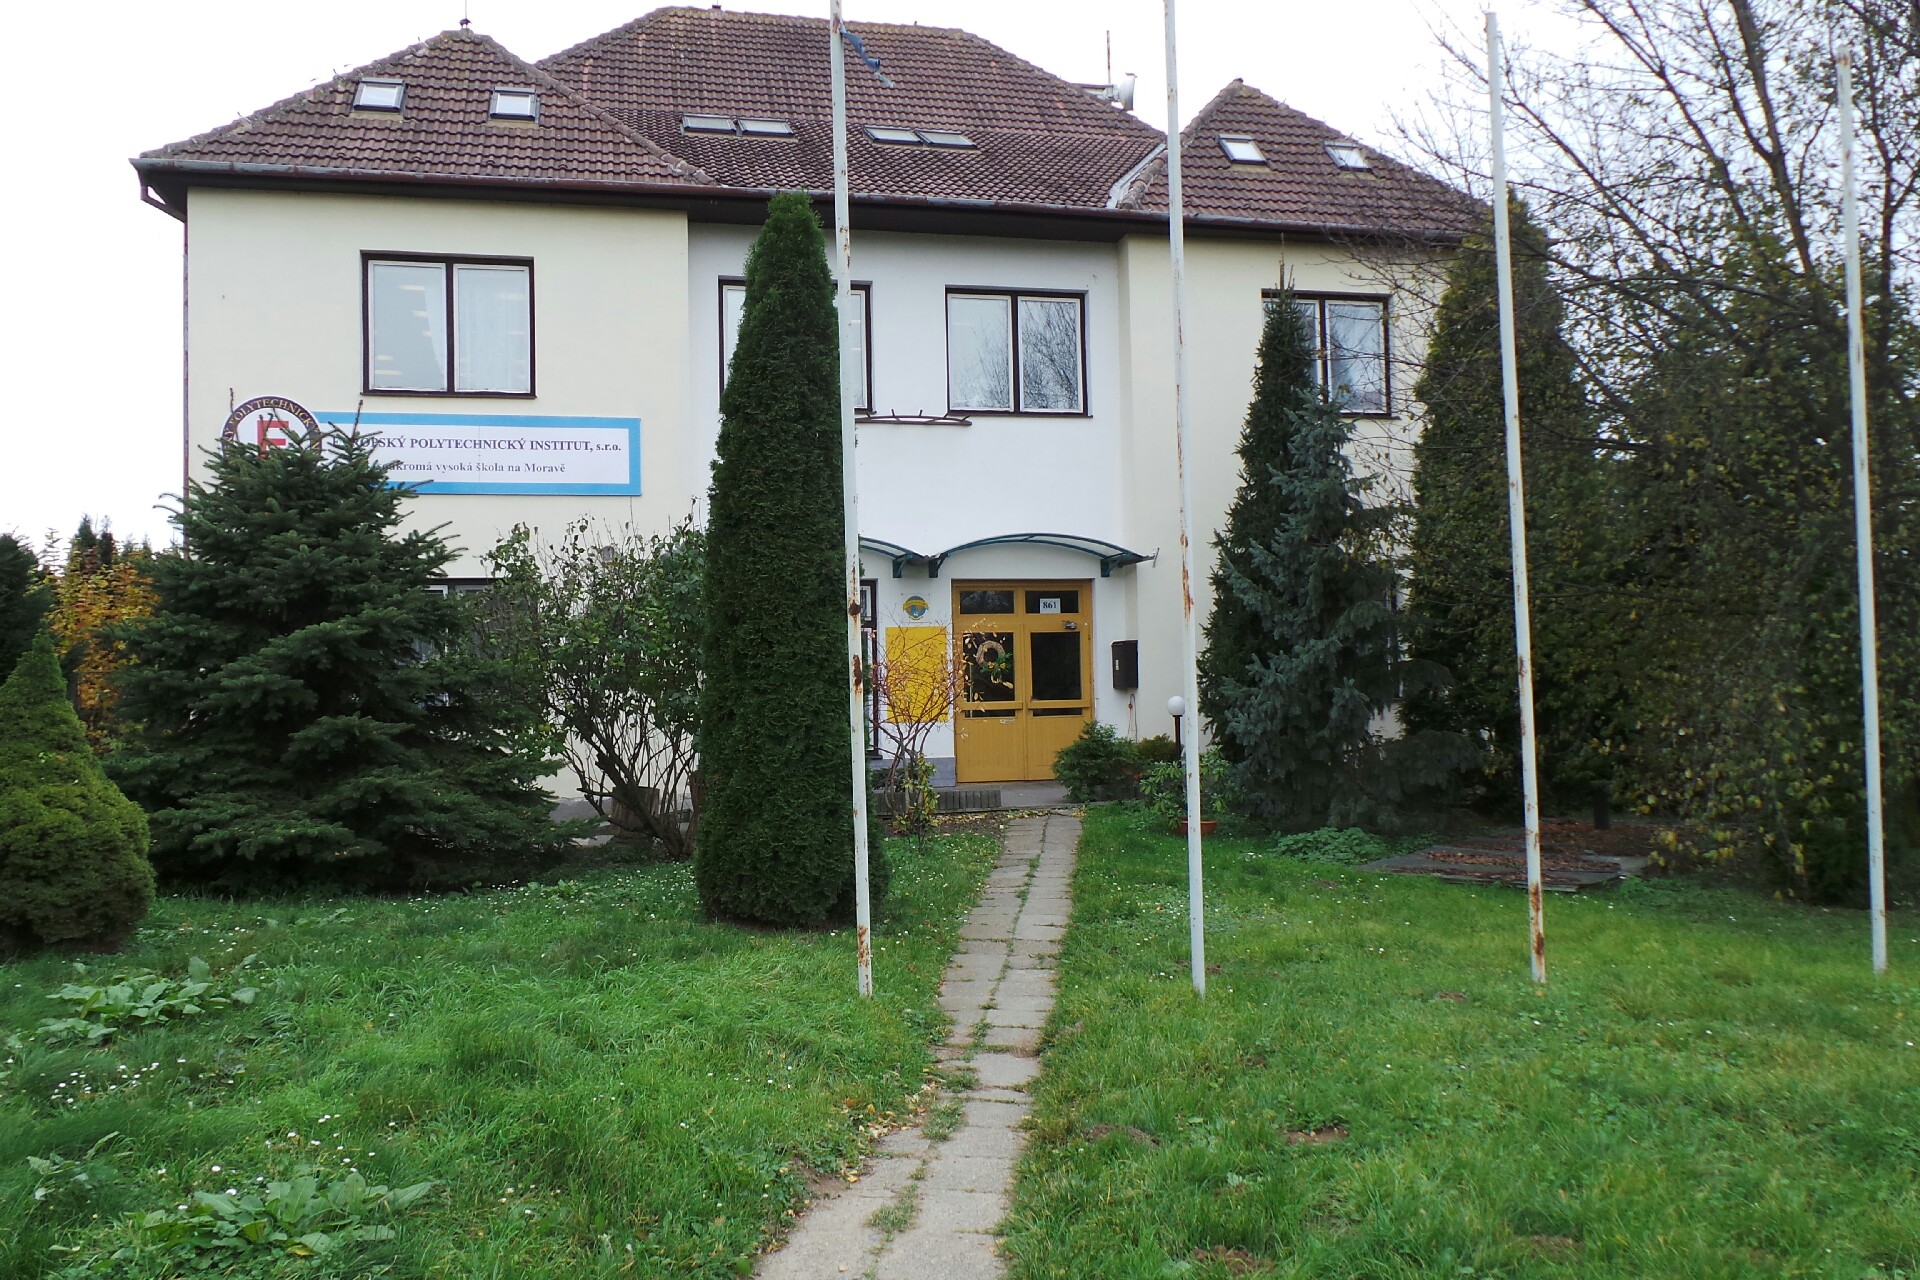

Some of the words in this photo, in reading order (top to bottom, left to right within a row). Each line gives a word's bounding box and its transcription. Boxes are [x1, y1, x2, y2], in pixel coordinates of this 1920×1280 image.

[332, 435, 406, 448] EROPSKÝ
[410, 437, 526, 451] POLYTECHNICKÝ
[530, 440, 593, 452] INSTITUT,
[596, 443, 622, 452] s.r.o.
[436, 462, 473, 474] vysoká
[476, 462, 504, 472] škola
[524, 463, 566, 473] Moravě
[1042, 601, 1057, 609] 861
